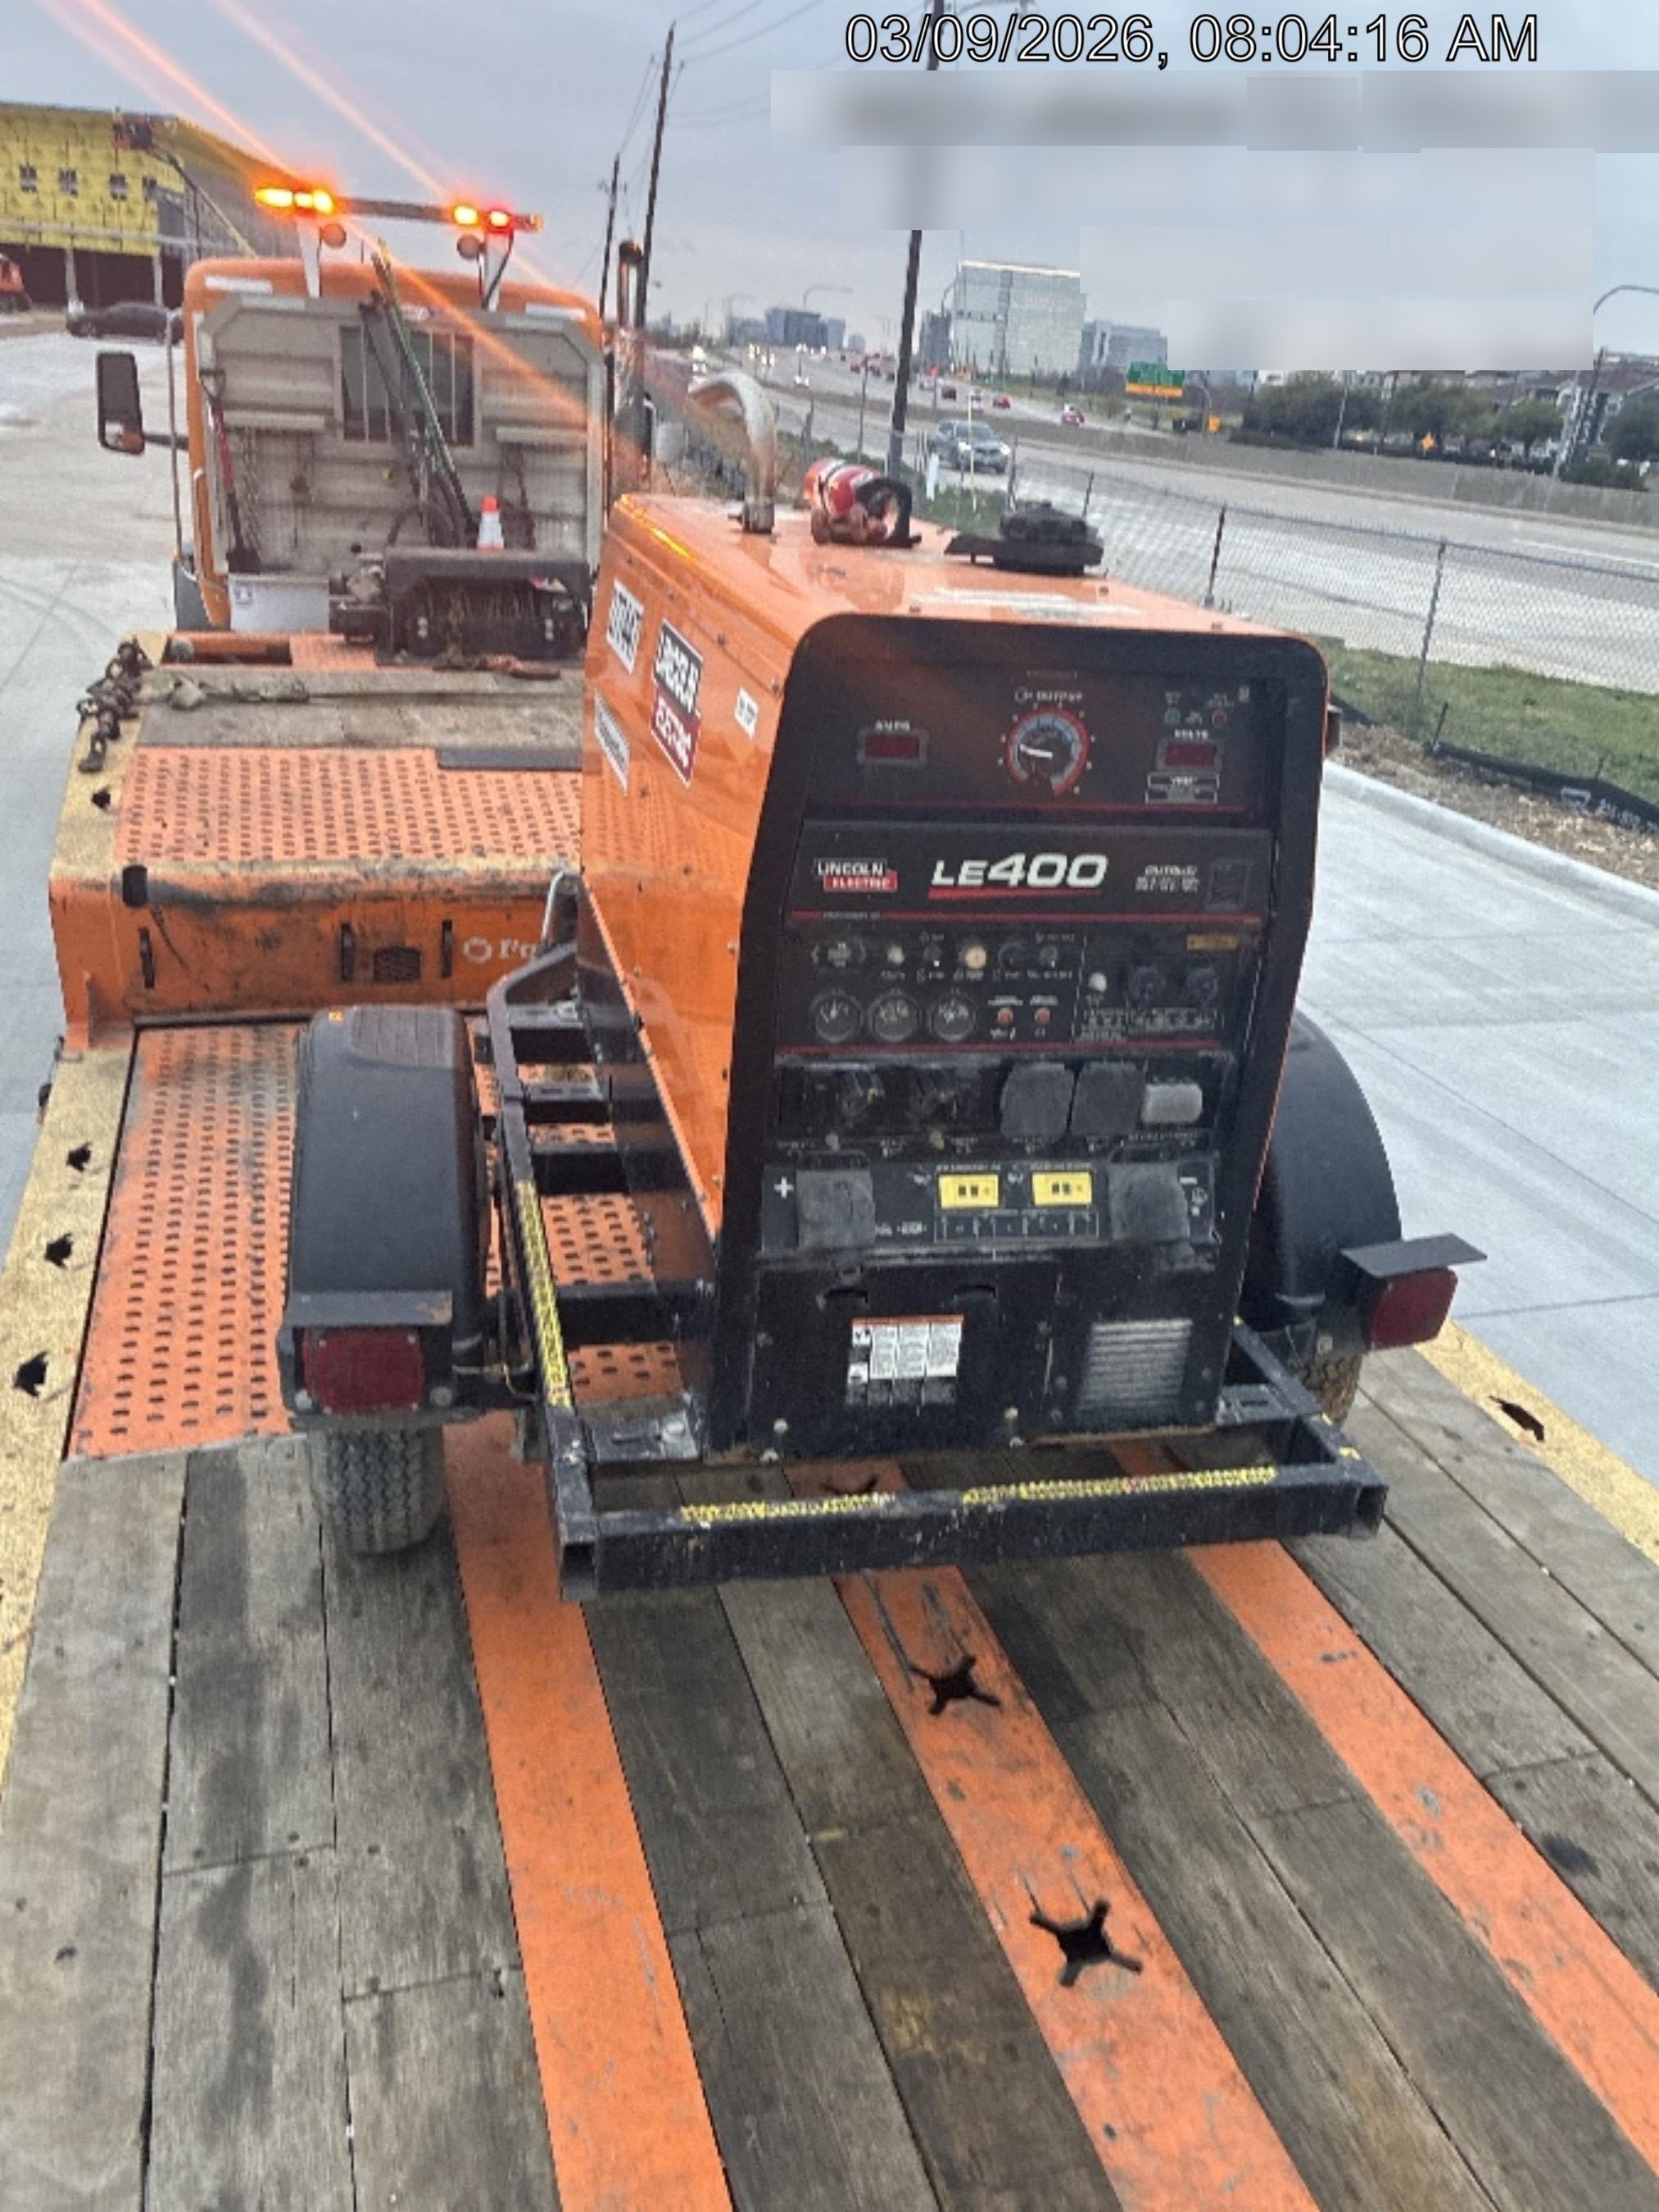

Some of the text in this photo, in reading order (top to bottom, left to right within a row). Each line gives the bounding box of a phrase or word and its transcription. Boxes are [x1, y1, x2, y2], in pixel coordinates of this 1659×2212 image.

[818, 861, 884, 877] LINCOLN
[931, 853, 1108, 888] LE400
[832, 876, 891, 889] ELECTRIC
